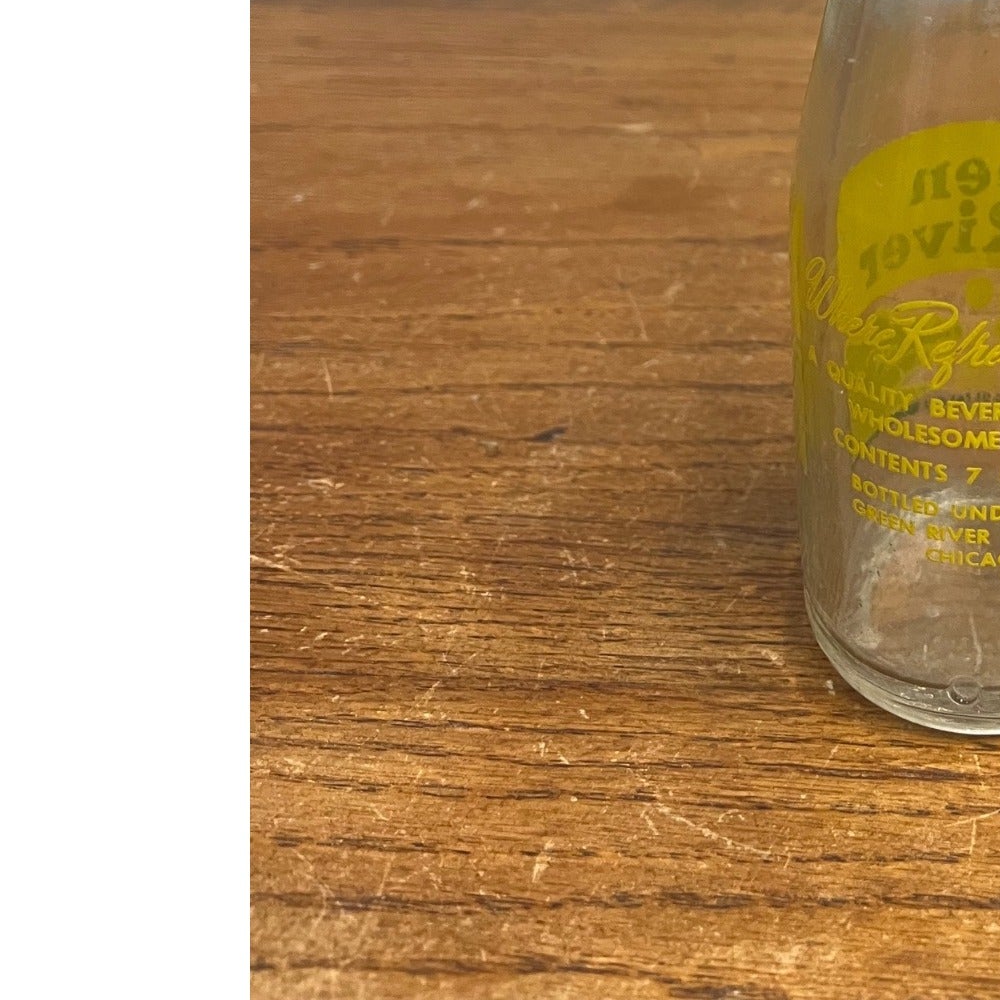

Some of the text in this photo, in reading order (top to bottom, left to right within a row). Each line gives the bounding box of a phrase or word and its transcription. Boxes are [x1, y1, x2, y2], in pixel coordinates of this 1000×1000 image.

[826, 360, 914, 411] QUALITY
[847, 399, 1000, 450] WHOLESOME
[832, 427, 948, 482] CONTENTS
[965, 467, 983, 485] 7
[851, 473, 939, 517] BOTTLED
[852, 498, 916, 537] GREEN
[926, 525, 991, 546] RIVER
